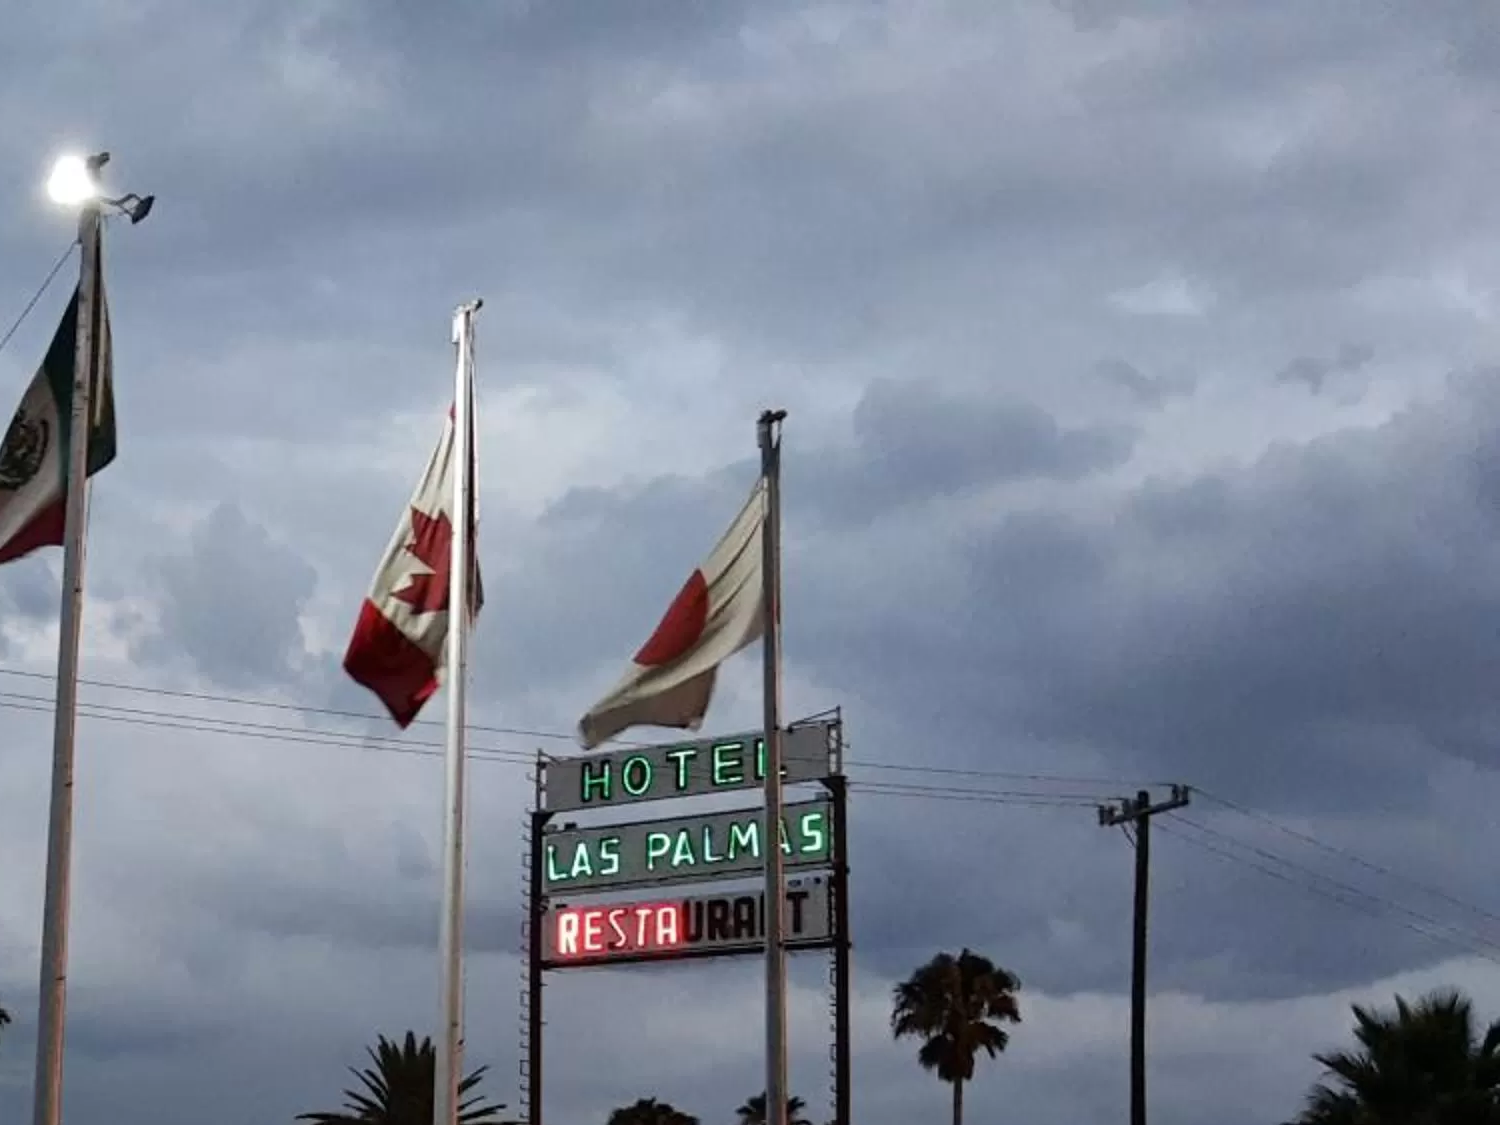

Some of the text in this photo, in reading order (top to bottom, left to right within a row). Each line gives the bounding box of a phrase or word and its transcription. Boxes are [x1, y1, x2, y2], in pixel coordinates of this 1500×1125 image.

[581, 739, 787, 800] HOTEL
[547, 813, 823, 881] LAS PALMAS
